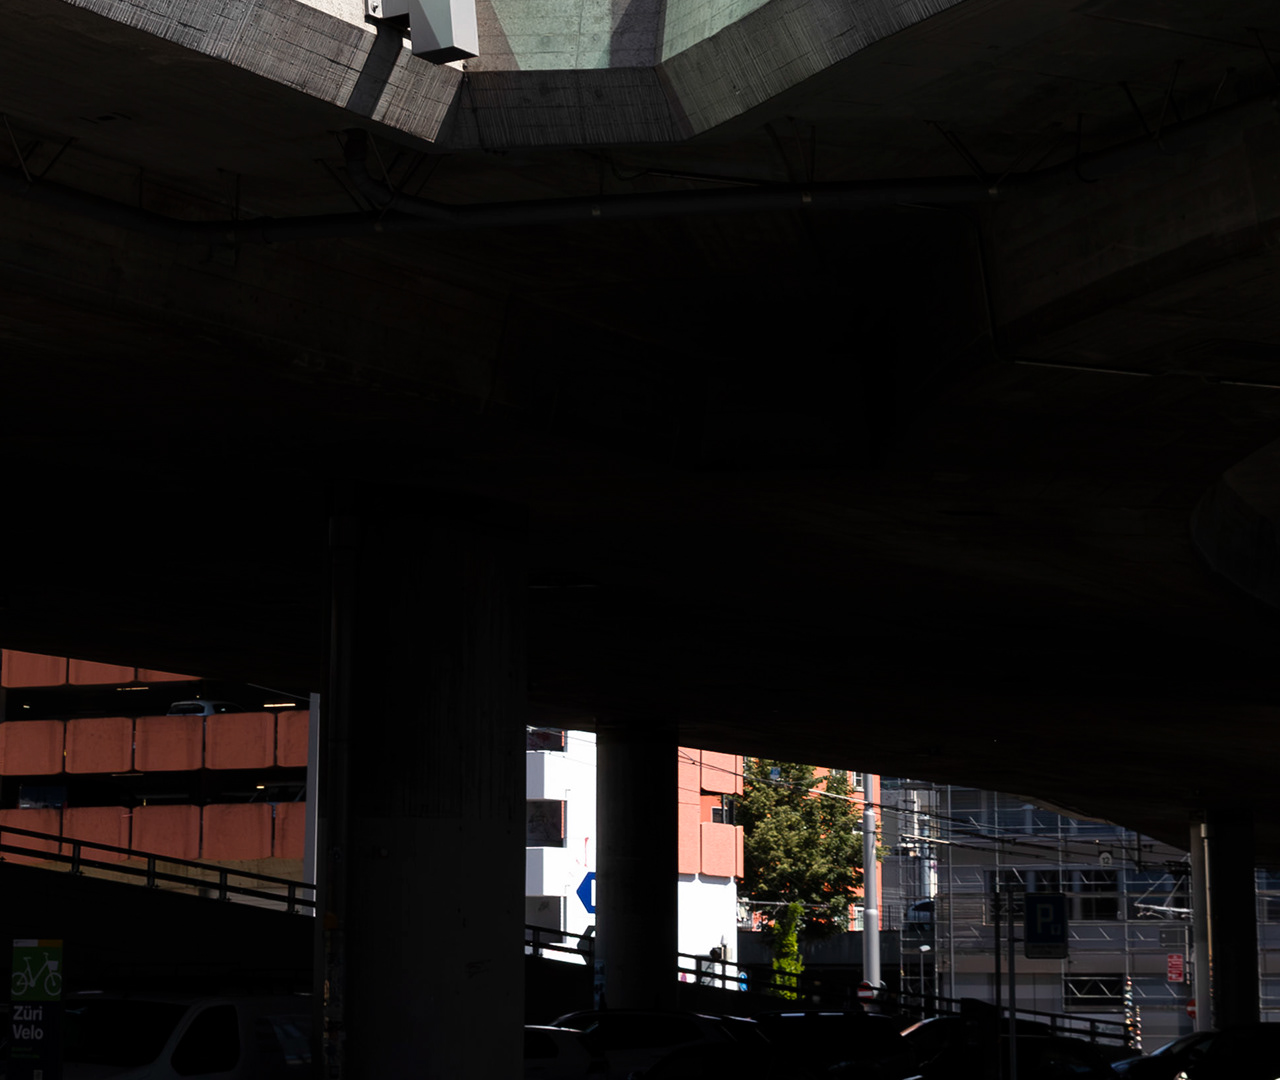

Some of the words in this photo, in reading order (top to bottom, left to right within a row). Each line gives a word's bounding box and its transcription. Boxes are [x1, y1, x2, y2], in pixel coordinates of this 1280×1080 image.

[1036, 903, 1055, 934] P
[13, 1006, 43, 1021] Züri
[12, 1024, 44, 1040] Velo
